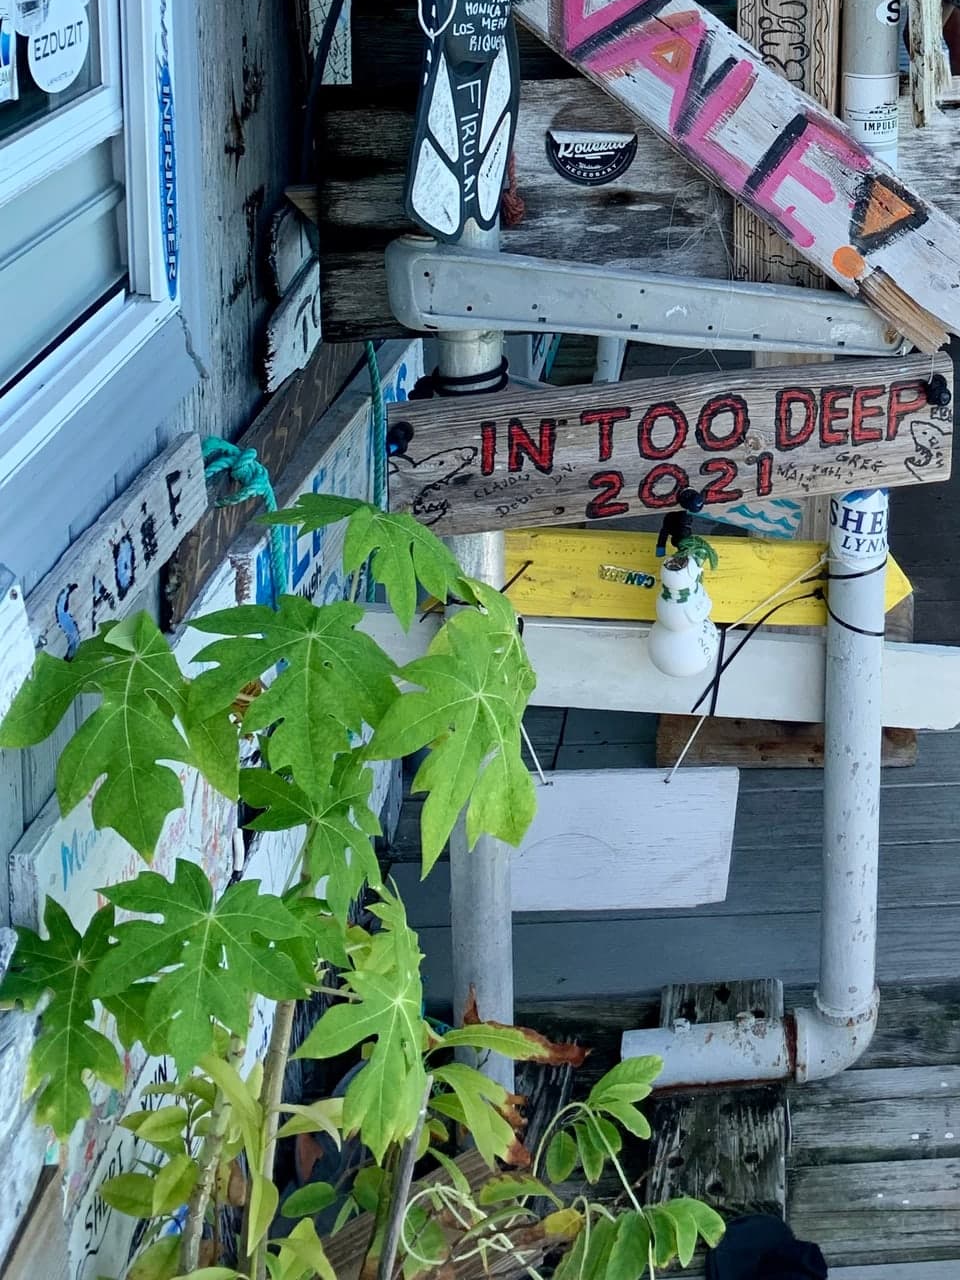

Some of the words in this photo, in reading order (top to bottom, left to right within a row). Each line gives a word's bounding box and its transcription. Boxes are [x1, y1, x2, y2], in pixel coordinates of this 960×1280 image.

[34, 20, 84, 62] EZDUZIT
[453, 22, 475, 37] LOS
[162, 84, 177, 281] INFRINGER
[480, 417, 558, 477] IN
[579, 391, 752, 464] TOO
[775, 378, 932, 454] DEEP
[585, 451, 774, 520] 2021
[829, 497, 889, 536] SHE
